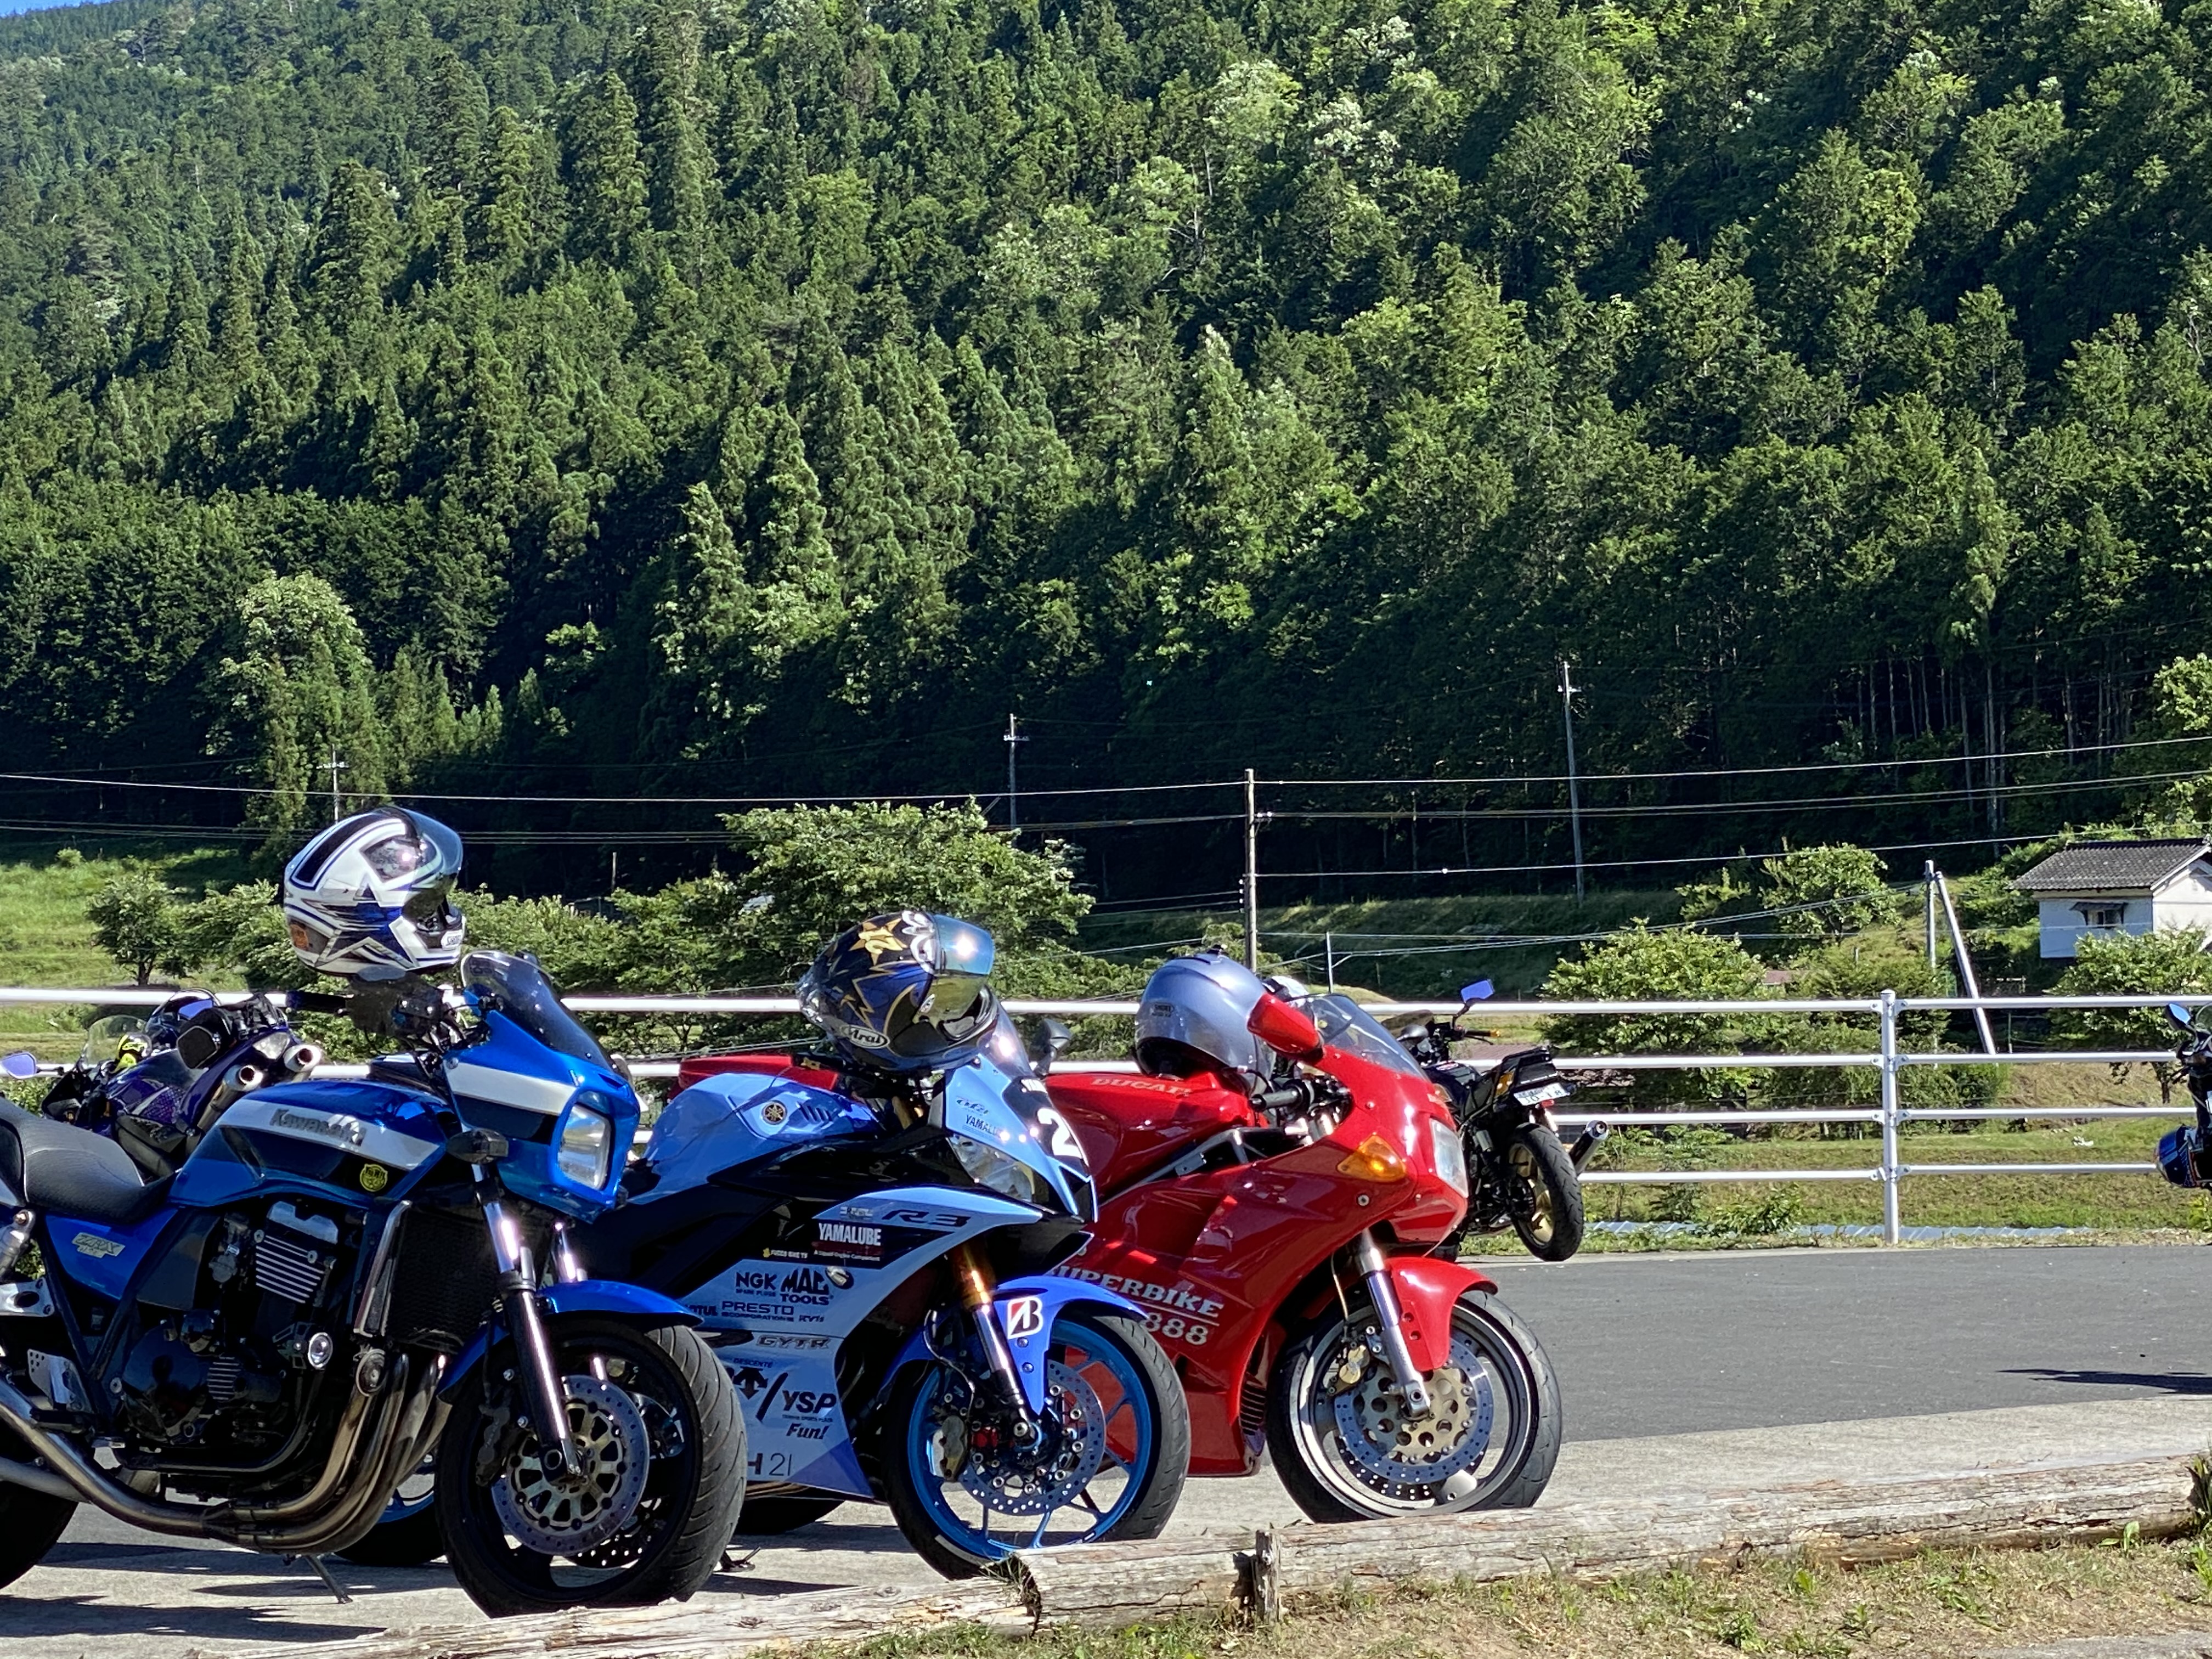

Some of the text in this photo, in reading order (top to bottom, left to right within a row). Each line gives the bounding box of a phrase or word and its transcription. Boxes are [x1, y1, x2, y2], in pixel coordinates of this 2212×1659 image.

[850, 1028, 881, 1044] Arai
[1090, 1077, 1193, 1097] DUCATI
[269, 1107, 368, 1147] Kawasaki
[881, 1208, 972, 1228] R3
[818, 1222, 882, 1246] YAMALUBE
[735, 1272, 777, 1290] NGK
[780, 1267, 830, 1295] MAC
[721, 1301, 795, 1316] PRESTO
[780, 1293, 830, 1306] TOOLS
[757, 1335, 830, 1350] GYTR
[733, 1357, 773, 1368] DESCENTE
[782, 1390, 837, 1414] YSP
[786, 1423, 830, 1440] Fun!
